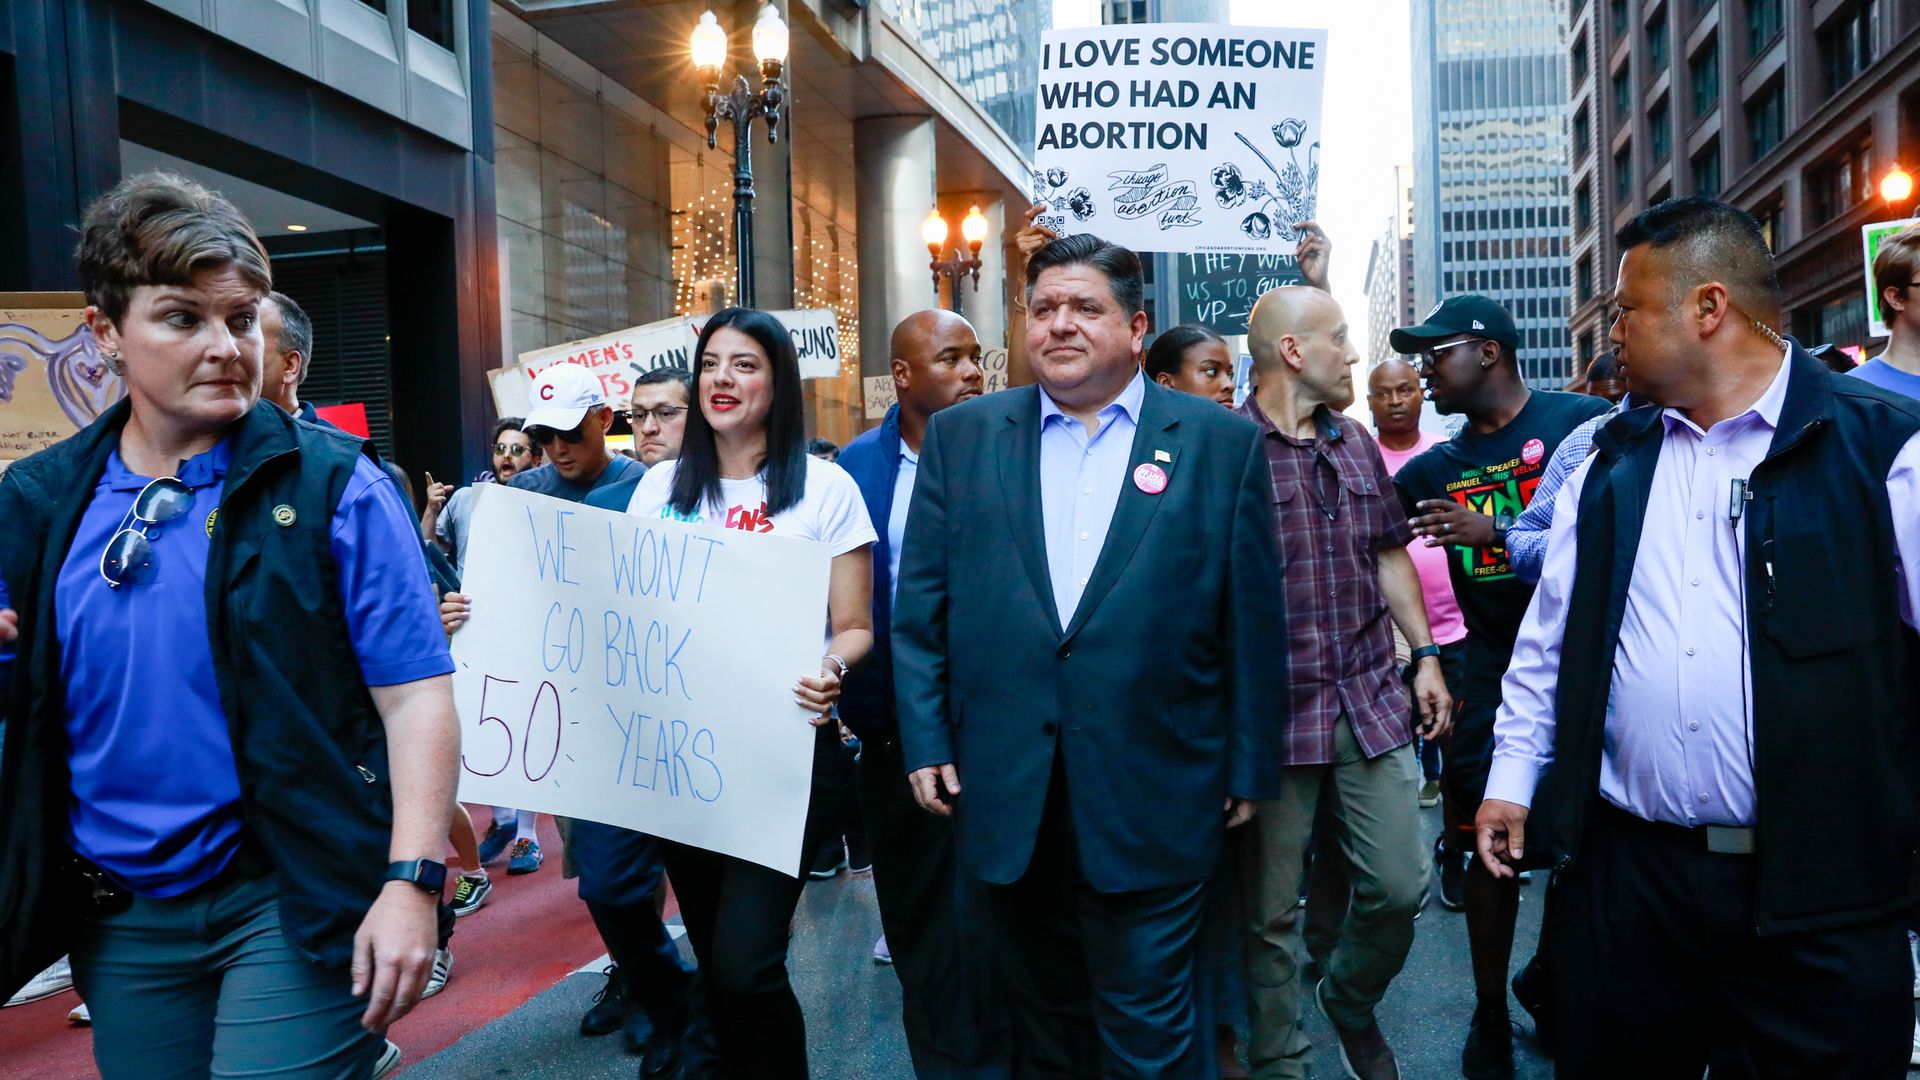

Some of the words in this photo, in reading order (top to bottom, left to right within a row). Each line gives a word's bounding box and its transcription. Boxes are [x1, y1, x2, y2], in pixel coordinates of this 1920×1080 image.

[1043, 43, 1050, 70] I
[1059, 38, 1140, 68] LOVE
[1150, 37, 1315, 69] SOMEONE
[1040, 80, 1120, 109] WHO
[1130, 80, 1199, 107] HAD
[1207, 81, 1256, 110] AN
[1037, 121, 1207, 150] ABORTION
[1122, 172, 1164, 189] chicago
[1186, 252, 1246, 275] THEY
[1186, 281, 1210, 300] US
[1223, 278, 1247, 299] TO
[790, 325, 836, 360] GUNS
[540, 384, 554, 401] C
[1446, 477, 1482, 492] EMANUEL
[526, 505, 580, 586] WE
[608, 520, 725, 602] WON'T
[542, 601, 584, 673] GO
[603, 610, 692, 700] BACK
[462, 674, 561, 782] 50
[606, 703, 723, 802] YEARS
